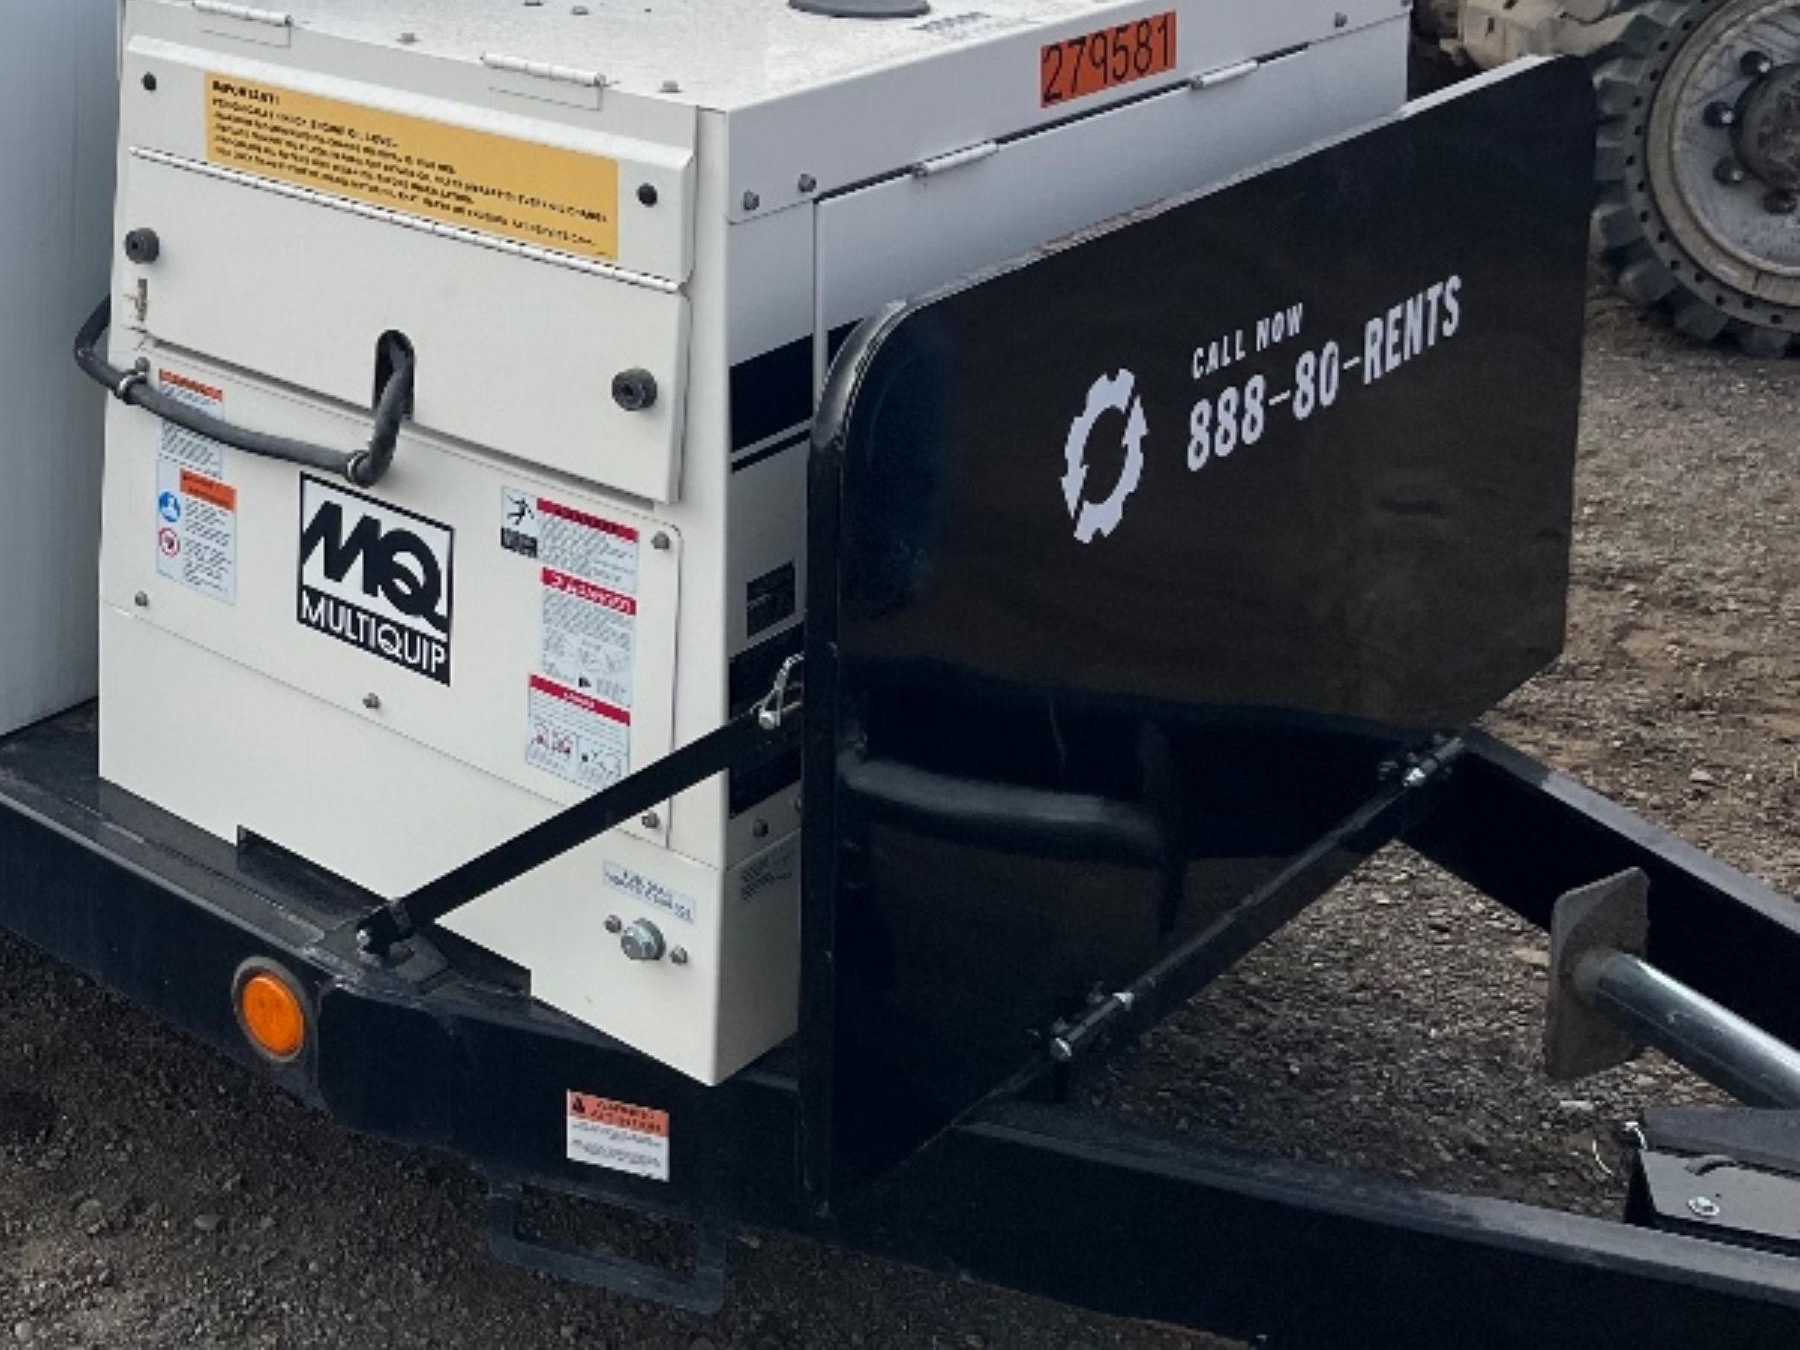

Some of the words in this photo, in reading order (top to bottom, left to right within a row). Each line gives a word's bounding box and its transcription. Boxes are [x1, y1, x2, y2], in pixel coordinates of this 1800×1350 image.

[1043, 14, 1170, 103] 279581
[1187, 275, 1462, 471] 888-80-RENTS
[1193, 330, 1246, 379] CALL
[1256, 302, 1303, 352] NOW
[302, 589, 446, 674] MULTIQUIP
